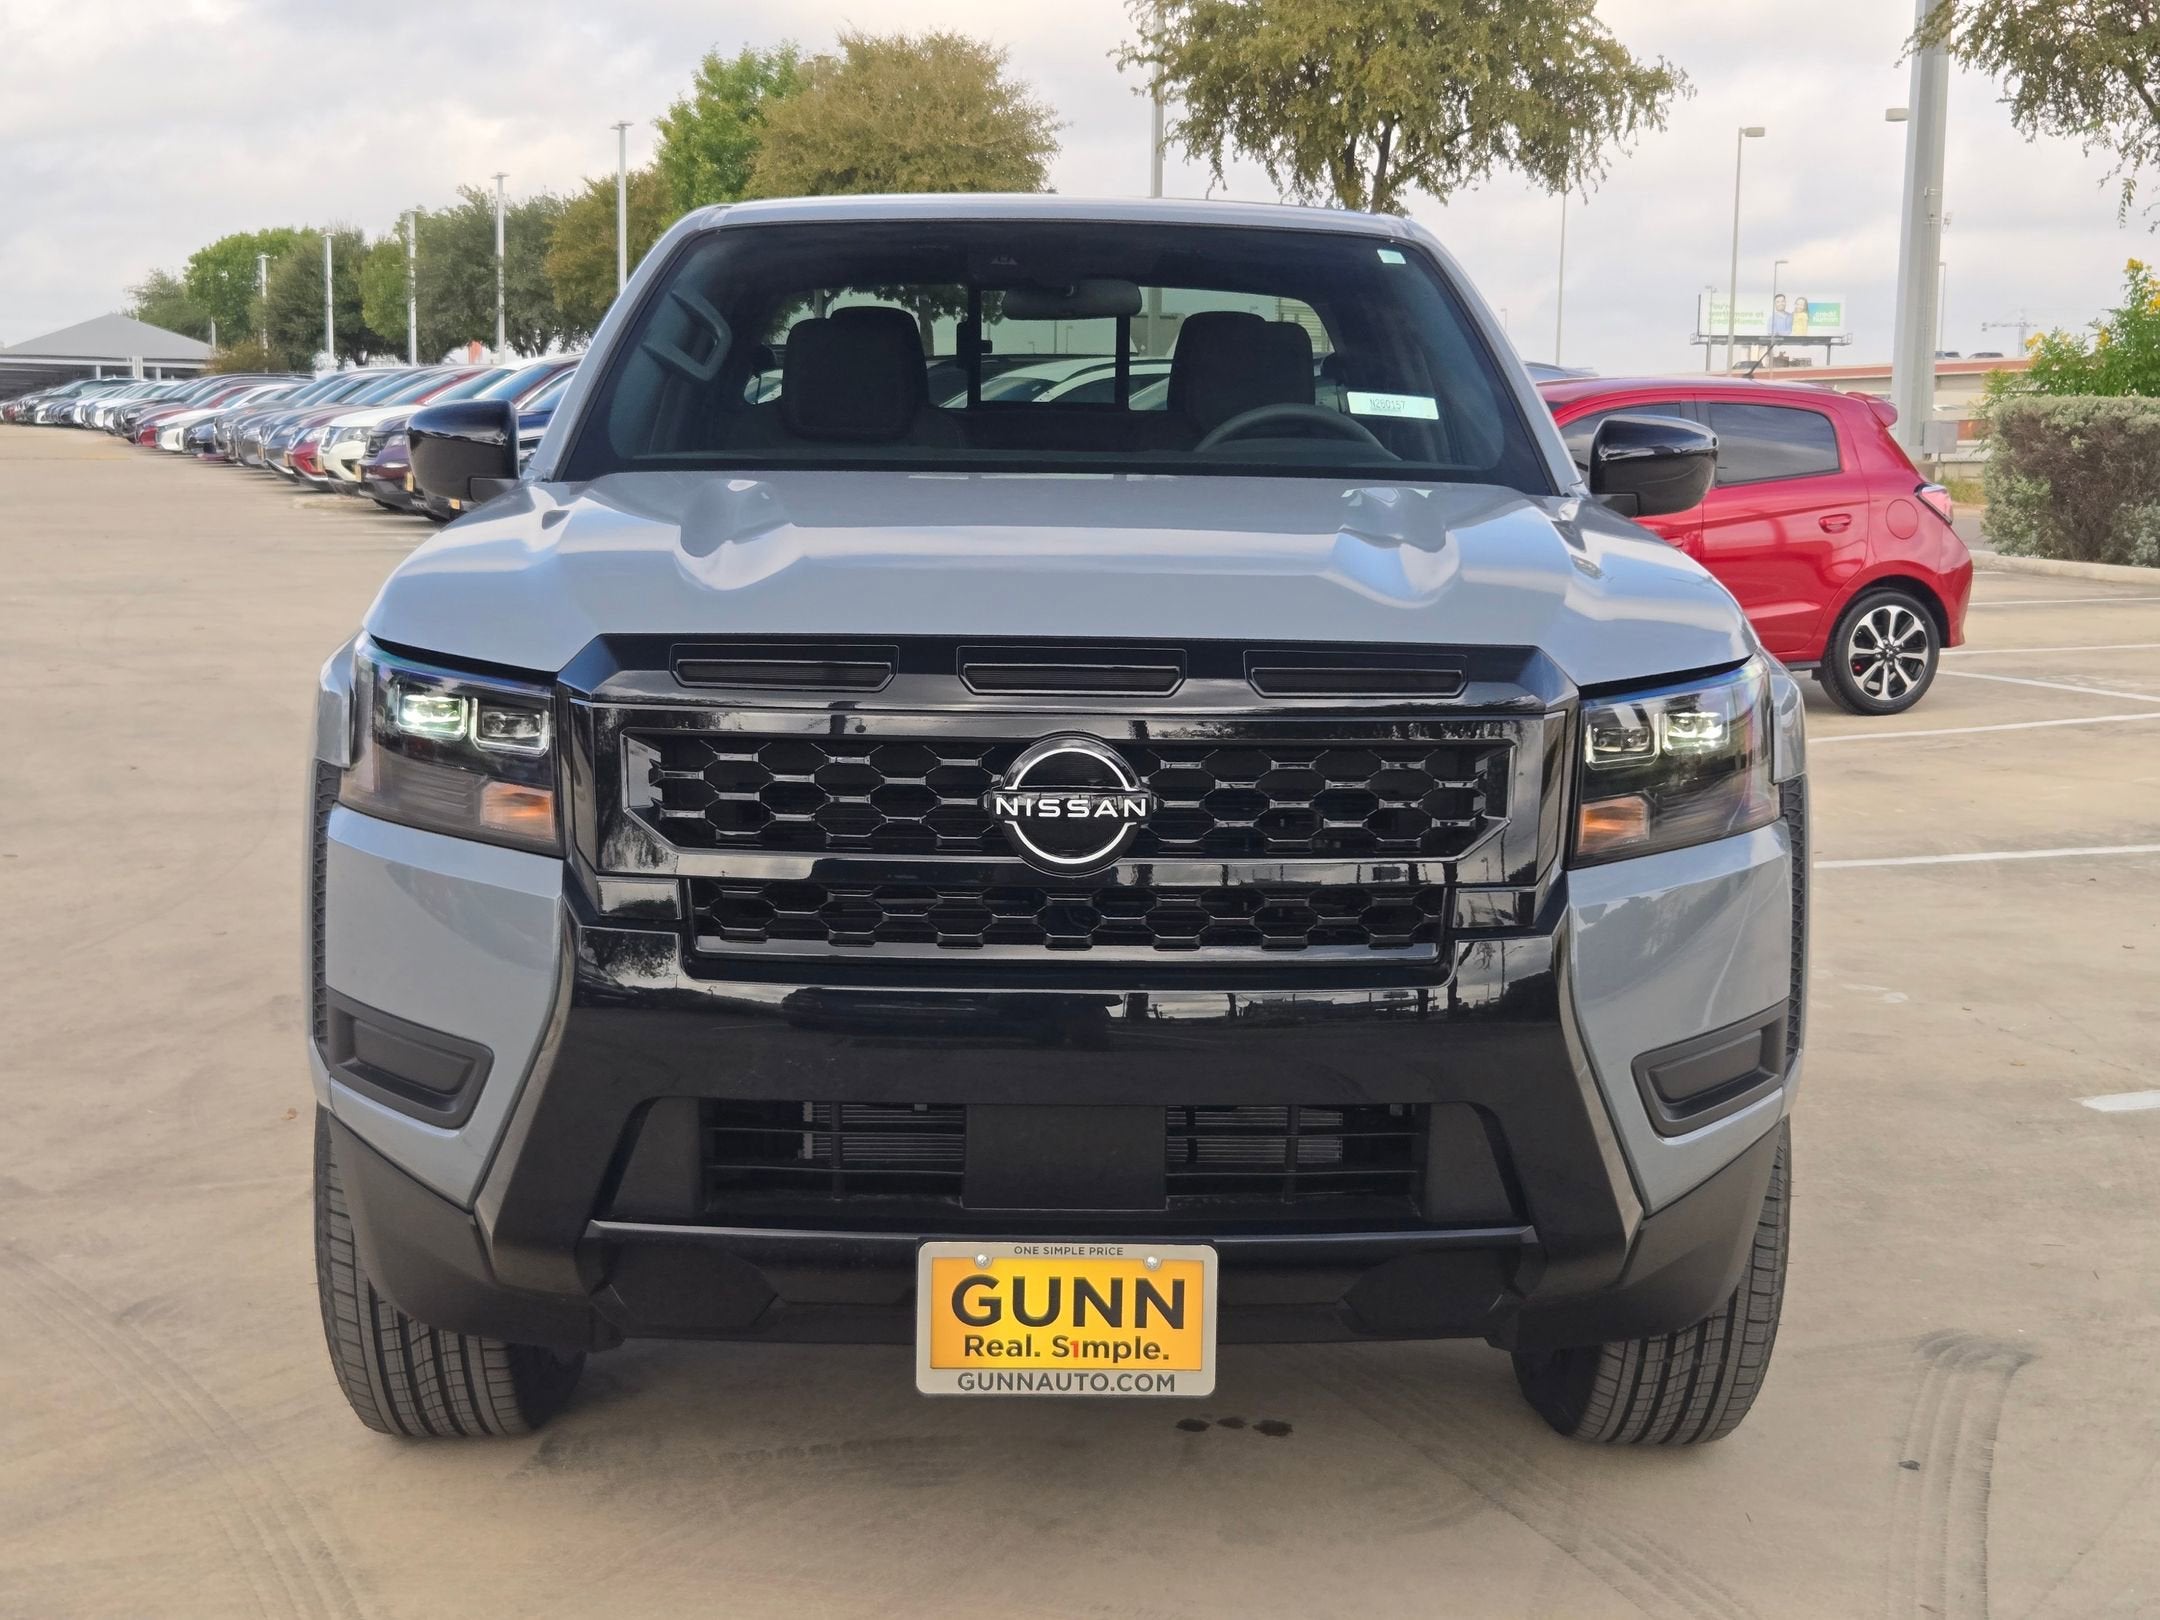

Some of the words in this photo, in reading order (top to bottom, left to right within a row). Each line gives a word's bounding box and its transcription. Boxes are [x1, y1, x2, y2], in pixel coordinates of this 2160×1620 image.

[995, 797, 1146, 818] NISSAN
[1014, 1246, 1039, 1255] ONE
[1043, 1246, 1085, 1256] SIMPLE
[1089, 1247, 1123, 1256] PRICE
[951, 1273, 1185, 1330] GUNN
[964, 1333, 1041, 1358] Real.
[957, 1372, 1175, 1392] GUNNAUTO.COM
